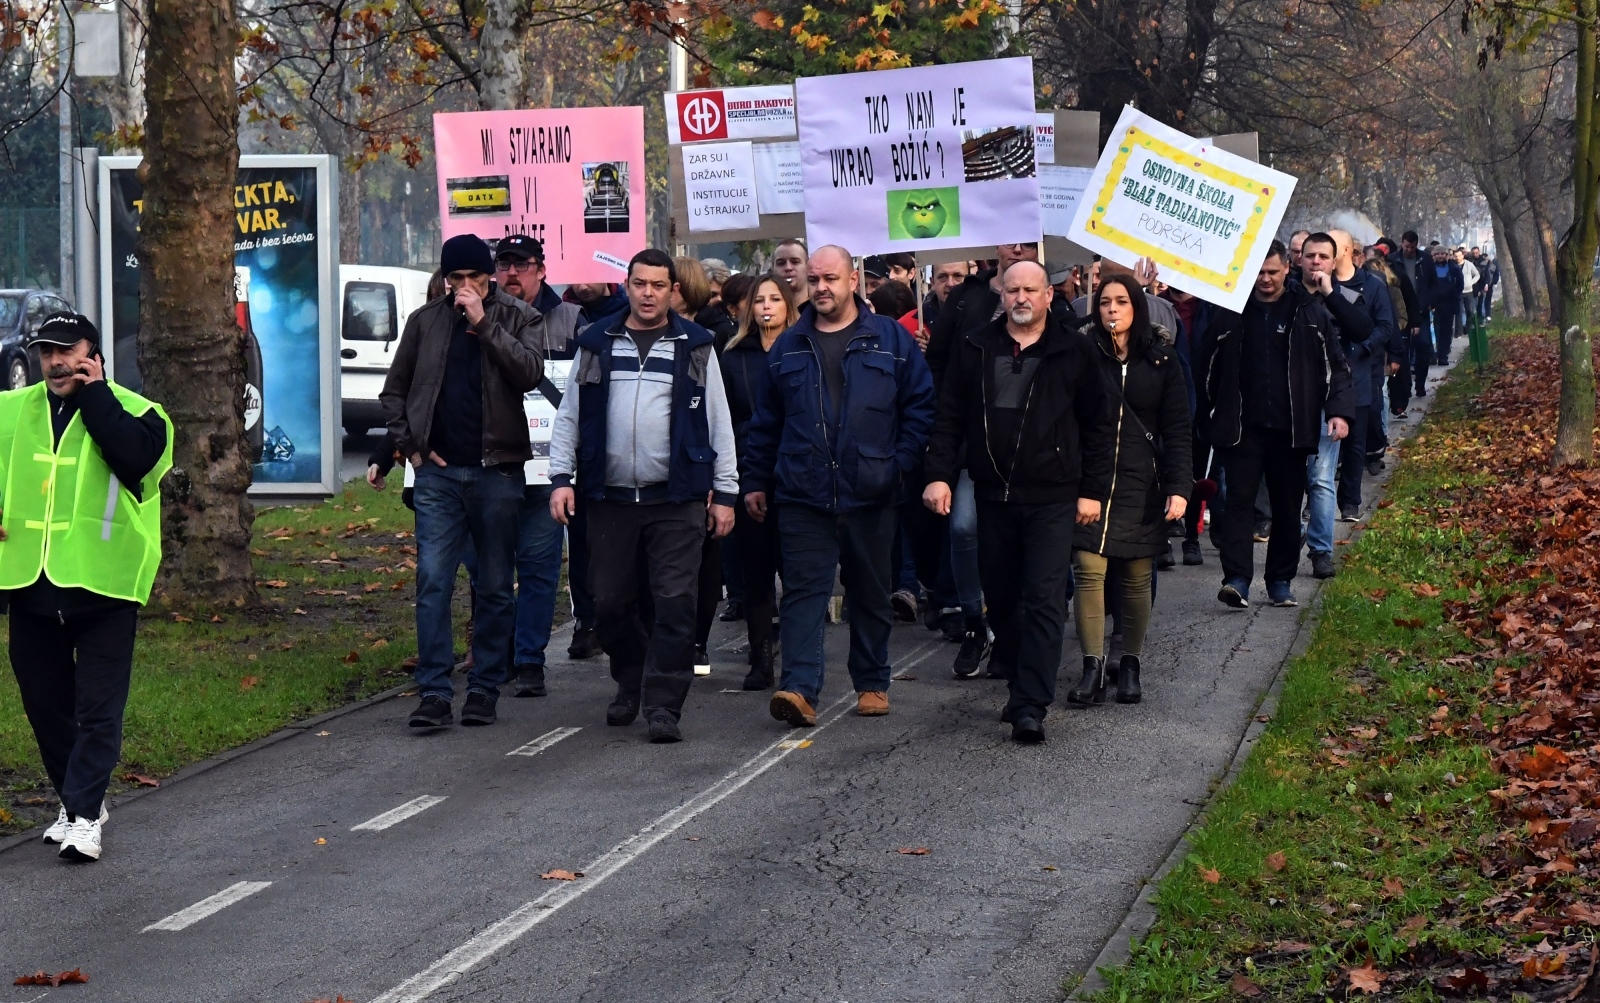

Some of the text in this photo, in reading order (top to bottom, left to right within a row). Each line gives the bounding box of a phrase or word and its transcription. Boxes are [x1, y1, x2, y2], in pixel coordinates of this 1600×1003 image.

[865, 87, 966, 134] TKO NAM JE
[481, 125, 572, 165] MI STVARAMO
[689, 154, 708, 164] ZAR
[710, 153, 723, 163] SU
[830, 146, 875, 188] UKRAO
[891, 131, 931, 182] BOŽIĆ
[690, 168, 736, 181] DRŽAVNE
[1142, 158, 1235, 212] OSNOVNA ŠKOLA
[524, 177, 538, 214] VI
[692, 188, 749, 200] INSTITUCIJE
[694, 204, 751, 216] U ŠTRAJKU?
[262, 234, 281, 248] bez
[281, 232, 315, 245] šećera
[1138, 212, 1203, 254] PODRŠKA
